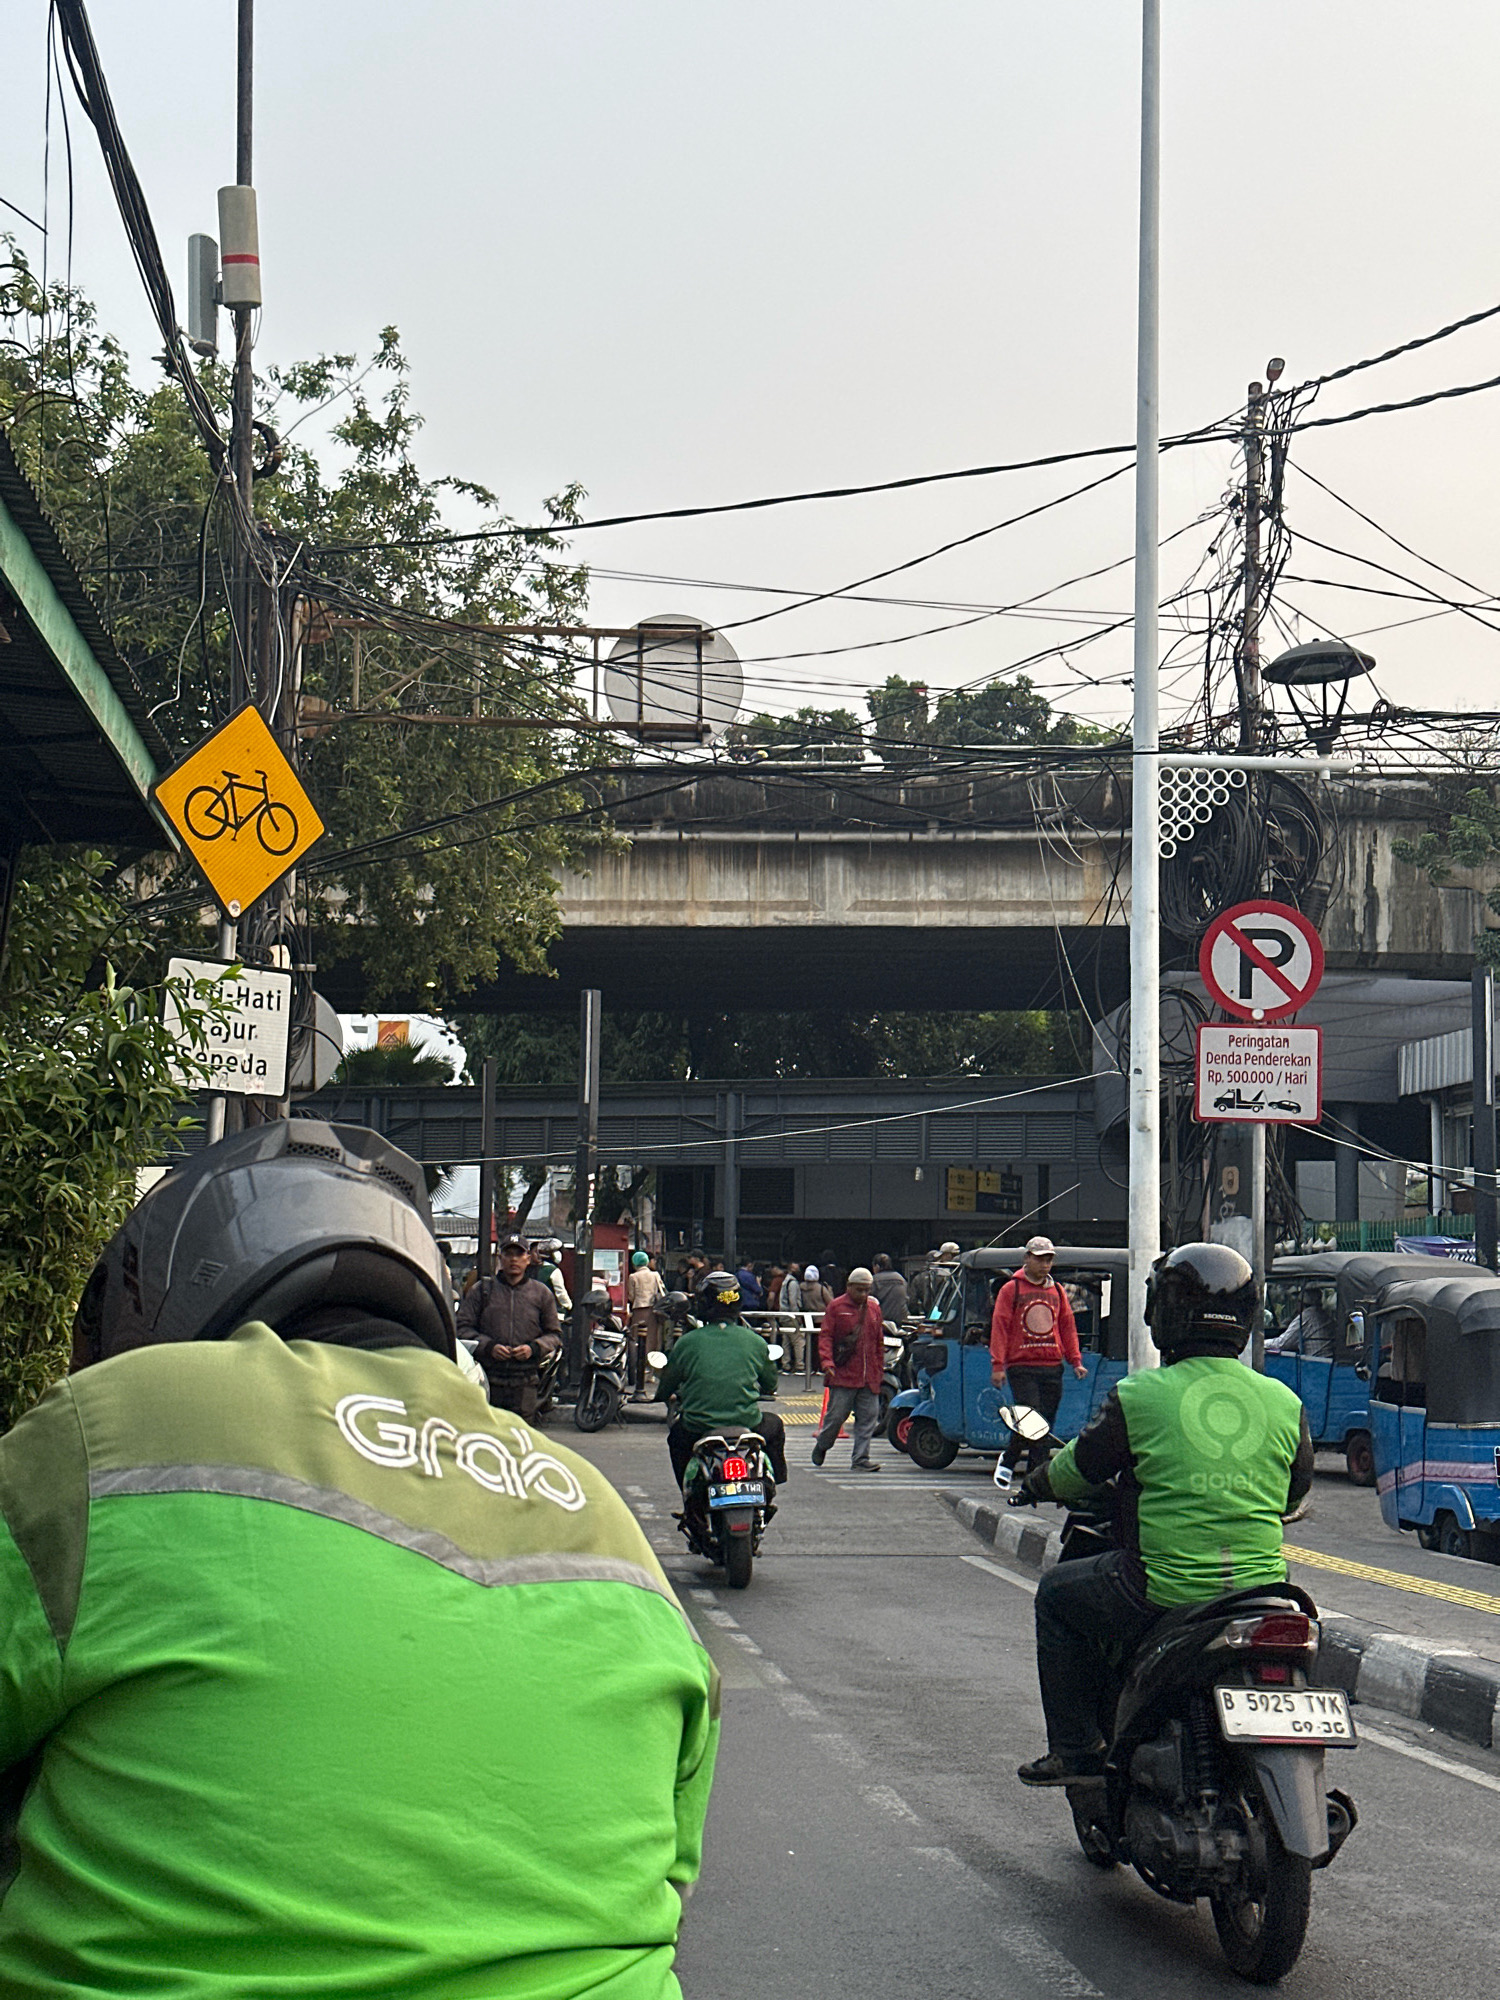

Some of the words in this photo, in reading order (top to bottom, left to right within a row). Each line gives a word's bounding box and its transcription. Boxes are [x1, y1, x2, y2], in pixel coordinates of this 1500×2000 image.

[1228, 1034, 1290, 1051] Peringatan
[1206, 1051, 1242, 1066] Denda
[1244, 1052, 1311, 1067] Penderekan
[1207, 1069, 1225, 1086] Rp.
[1227, 1070, 1274, 1085] 500.000
[1276, 1071, 1283, 1086] /
[1284, 1071, 1308, 1086] Hari
[1203, 1313, 1237, 1322] HONDA
[335, 1393, 587, 1512] Grab
[1222, 1692, 1235, 1711] B
[1246, 1693, 1296, 1713] 5925
[1304, 1695, 1343, 1715] TYK
